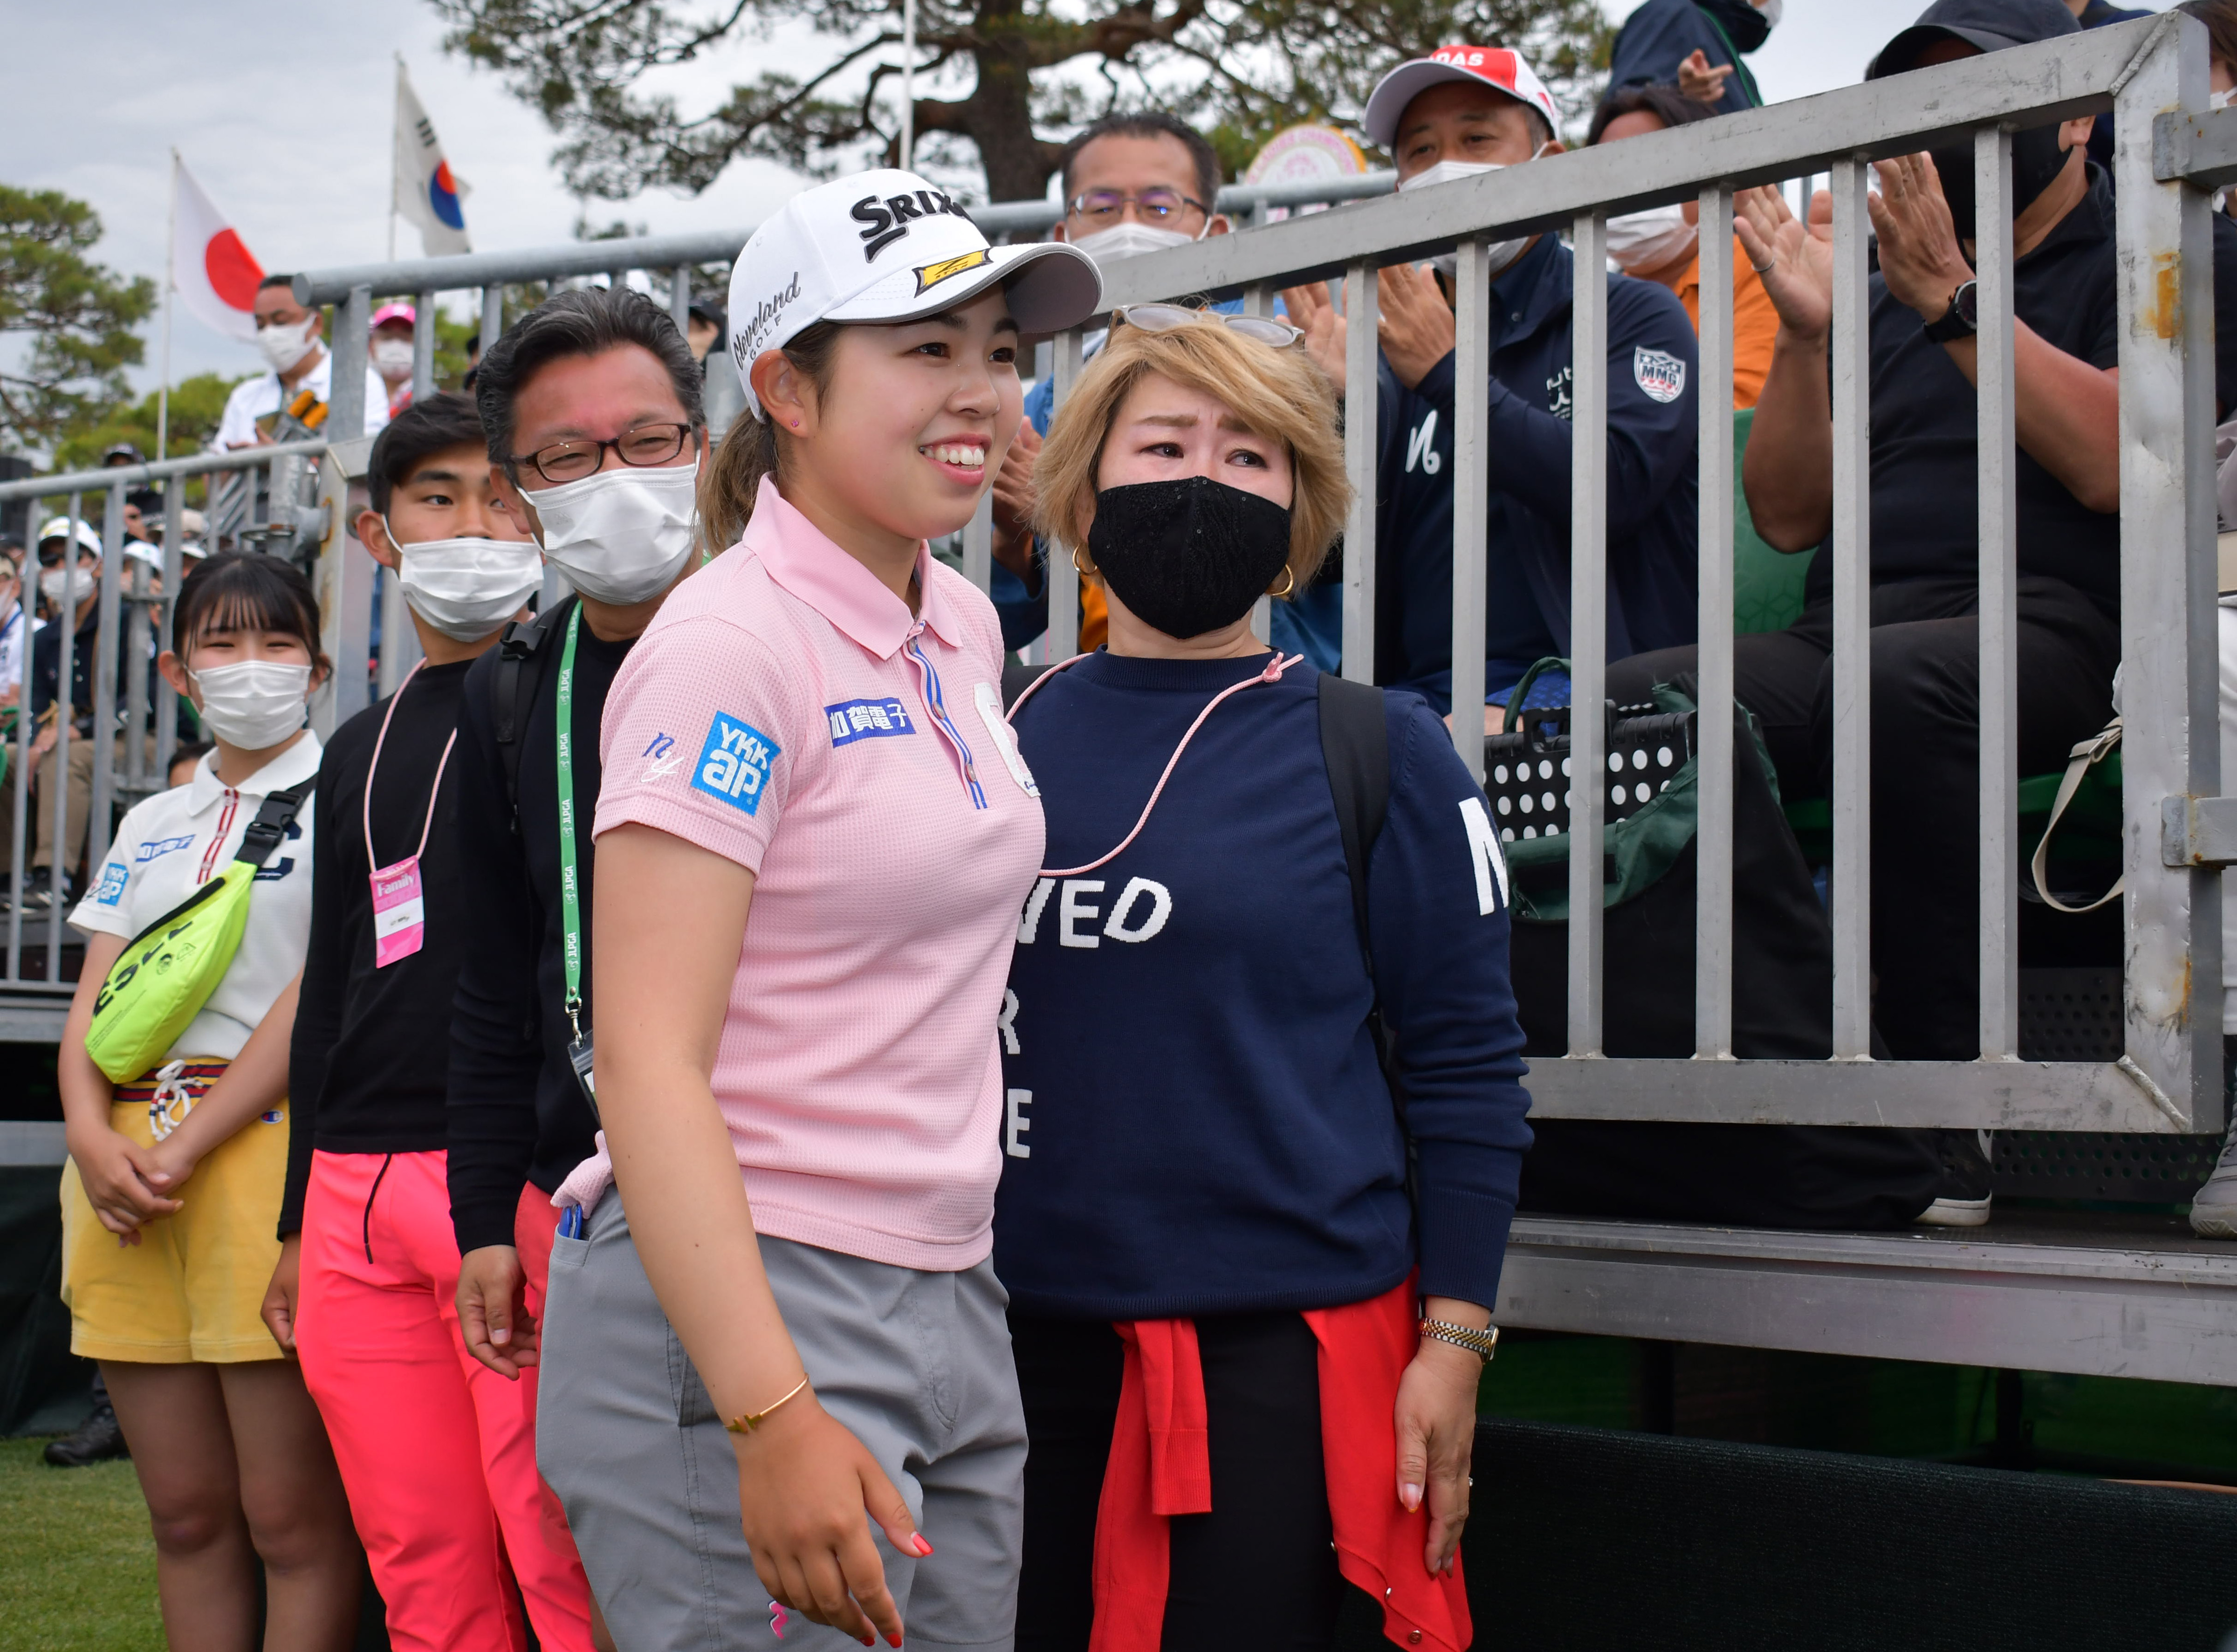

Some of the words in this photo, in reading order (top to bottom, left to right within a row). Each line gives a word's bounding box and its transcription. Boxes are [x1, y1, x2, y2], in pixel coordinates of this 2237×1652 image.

[733, 271, 801, 371] Cleveland
[749, 313, 782, 361] GOLF
[560, 669, 571, 692] JLPGA
[830, 703, 907, 740] 加賀電子
[560, 733, 569, 757] JLPGA
[721, 721, 769, 770] YKK
[702, 749, 762, 798] ap
[562, 799, 571, 824] JLPGA
[377, 873, 415, 898] Family
[565, 865, 574, 891] JLPGA
[567, 932, 577, 957] JLPGA
